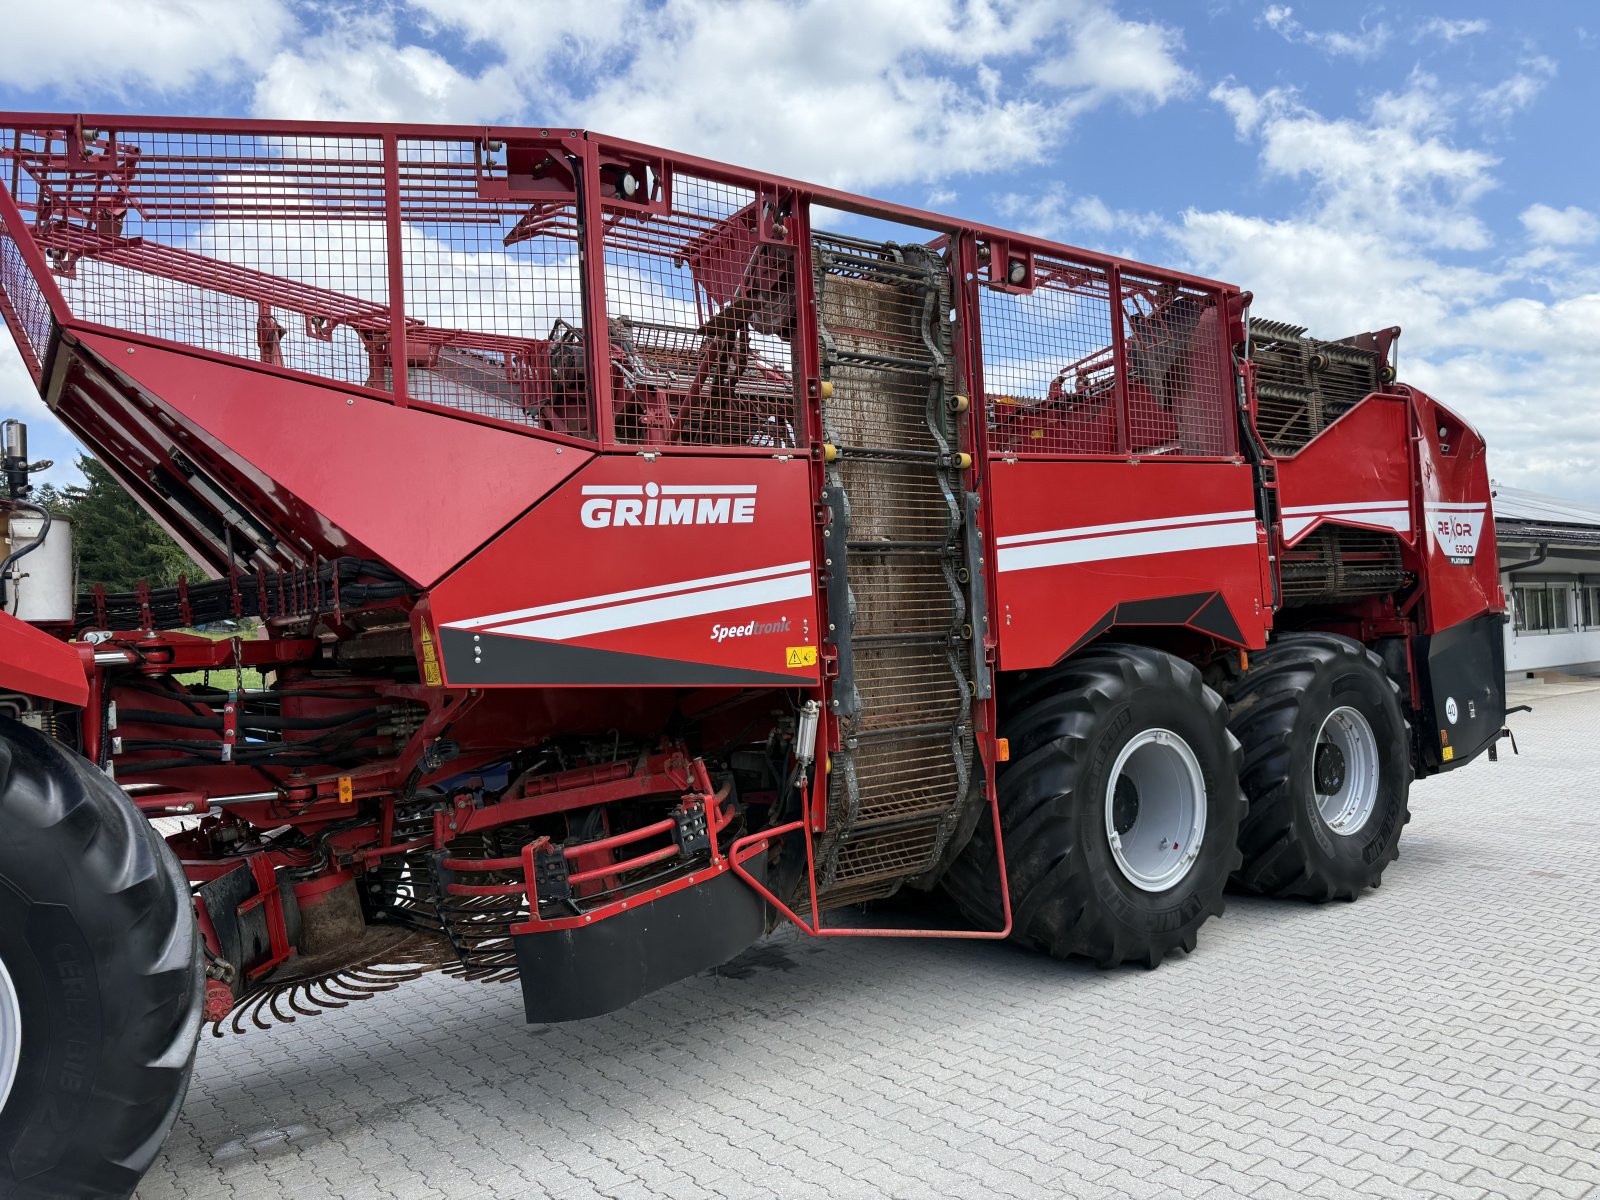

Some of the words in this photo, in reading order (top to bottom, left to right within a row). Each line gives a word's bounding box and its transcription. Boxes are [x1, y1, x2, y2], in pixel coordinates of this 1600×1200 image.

[580, 481, 757, 529] GRIMME
[1437, 516, 1472, 543] REXOR
[1455, 544, 1473, 554] 6300
[710, 616, 792, 643] Speedtronic
[1447, 703, 1456, 717] 40
